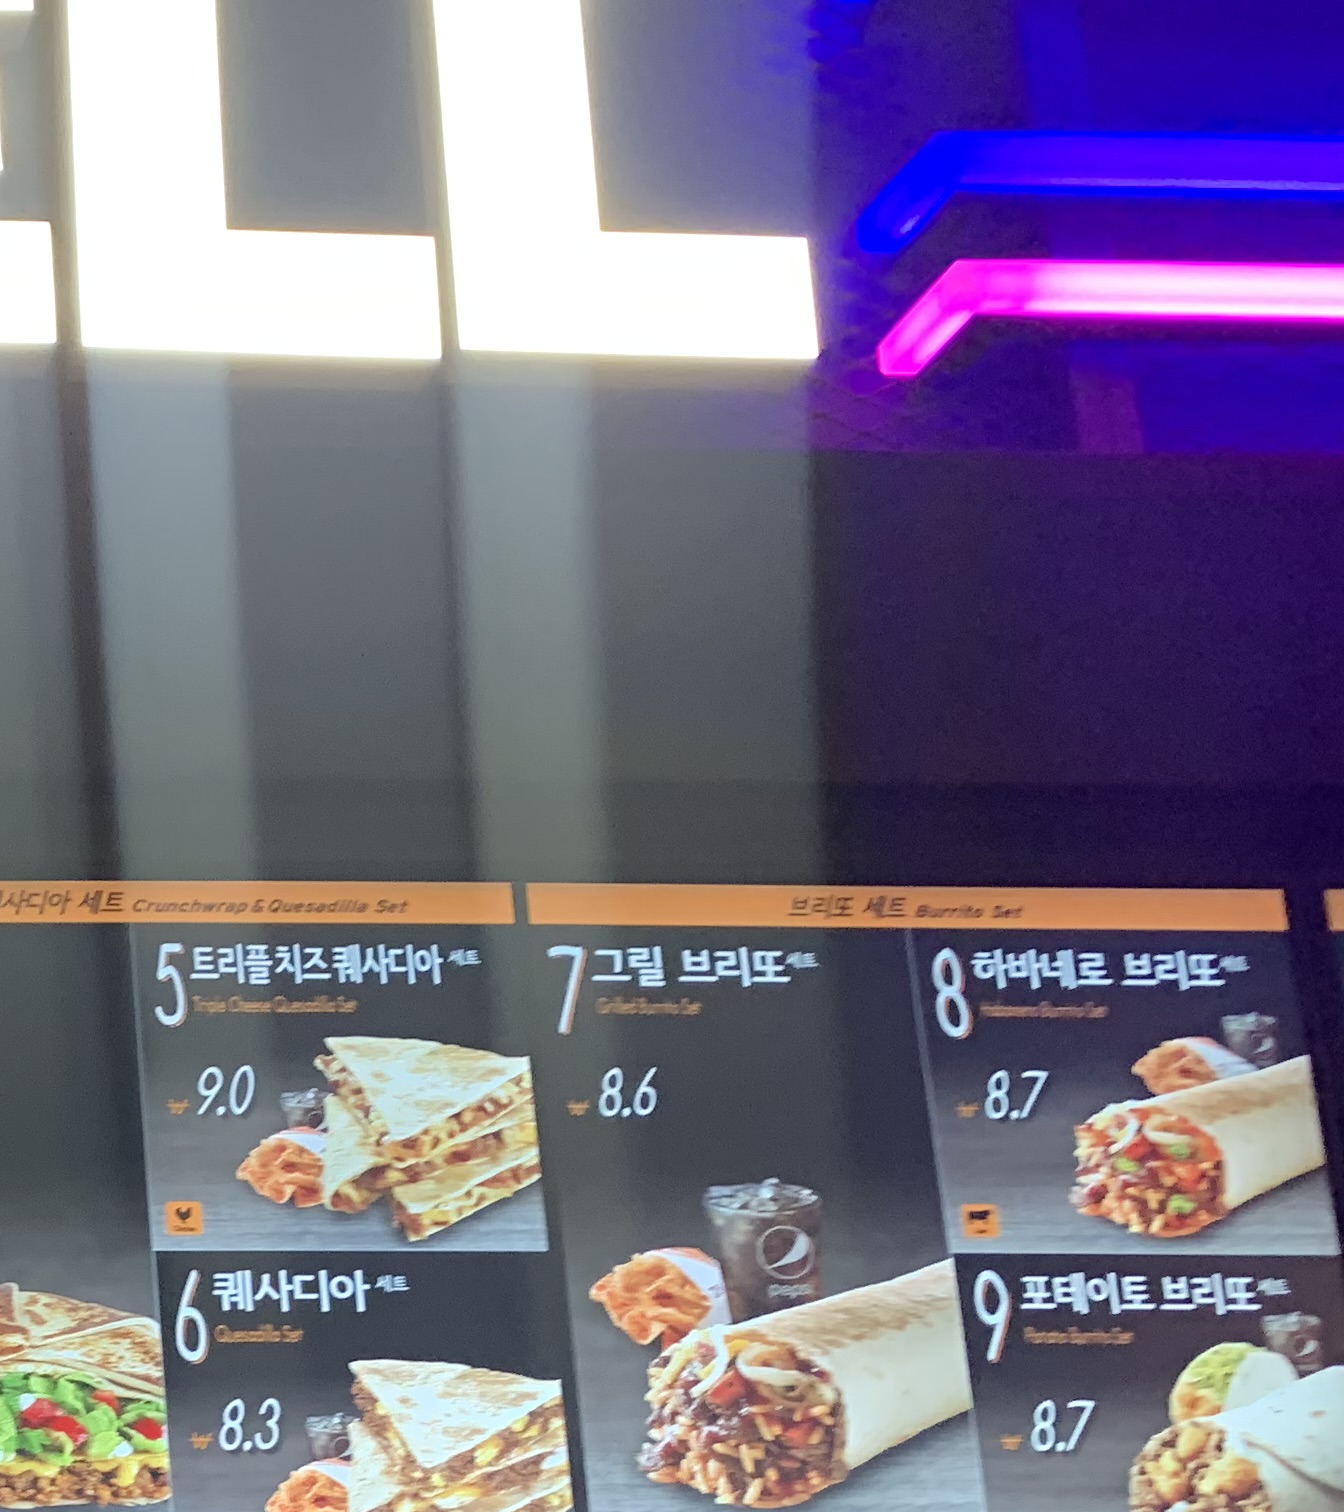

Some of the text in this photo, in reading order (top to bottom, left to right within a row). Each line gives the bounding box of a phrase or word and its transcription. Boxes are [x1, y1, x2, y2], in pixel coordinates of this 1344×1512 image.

[79, 890, 125, 914] 세트
[132, 898, 250, 916] Crunchwrap
[267, 898, 368, 915] Quesadilla
[374, 899, 409, 914] Set
[787, 895, 1025, 919] 브리또 세트 Burrito Set
[447, 949, 483, 967] 세트
[591, 945, 667, 988] 그릴
[678, 945, 792, 989] 브리또
[970, 948, 1226, 991] 하바네로 브리또
[154, 942, 187, 1028] 5
[546, 944, 588, 1036] 7
[932, 947, 973, 1039] 8
[197, 1064, 256, 1117] 9.0
[598, 1066, 659, 1118] 8.6
[984, 1069, 1049, 1121] 8.7
[212, 1269, 411, 1312] 퀘사디아 세트
[1020, 1272, 1262, 1315] 포테이토 브리또
[175, 1269, 209, 1365] 6
[974, 1270, 1012, 1364] 9
[218, 1397, 282, 1452] 8.3
[1030, 1400, 1096, 1453] 8.7
